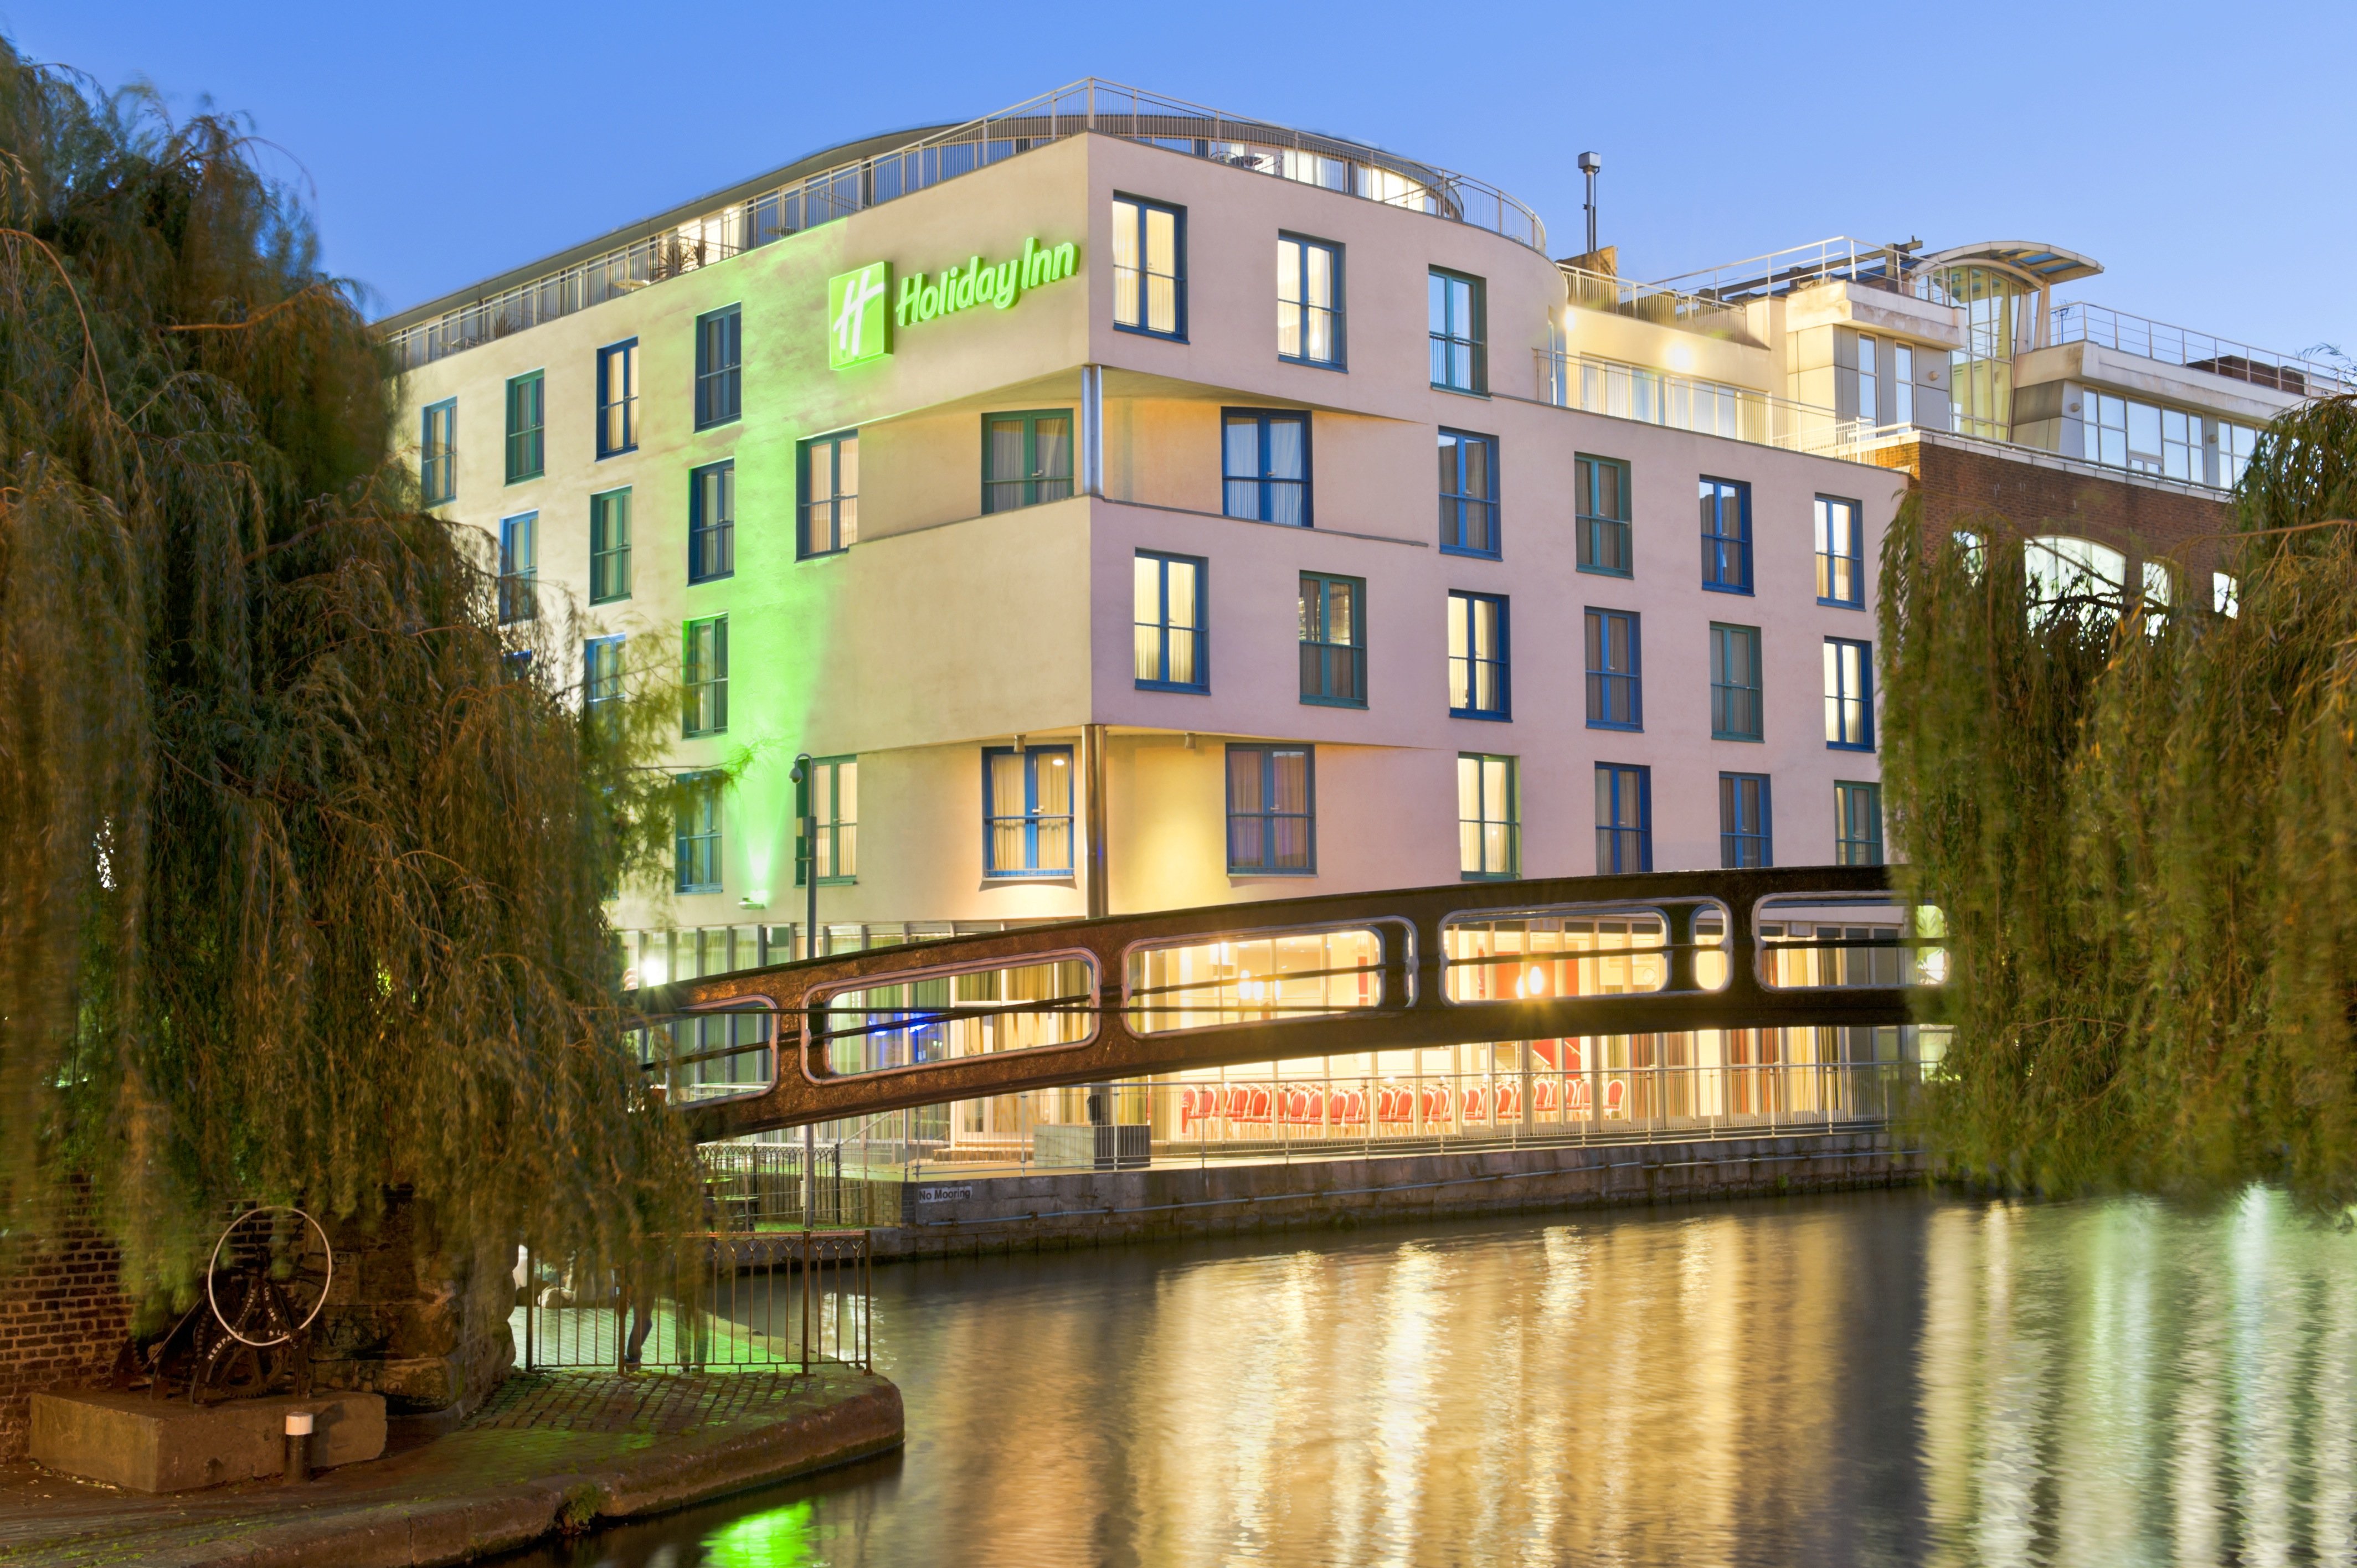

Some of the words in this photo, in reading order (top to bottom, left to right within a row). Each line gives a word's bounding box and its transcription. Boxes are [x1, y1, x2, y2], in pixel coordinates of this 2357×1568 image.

[896, 256, 1020, 327] Holiday
[1021, 237, 1077, 289] Inn
[919, 1191, 932, 1200] No
[934, 1189, 971, 1199] Mooring
[208, 1331, 244, 1360] REDPAH
